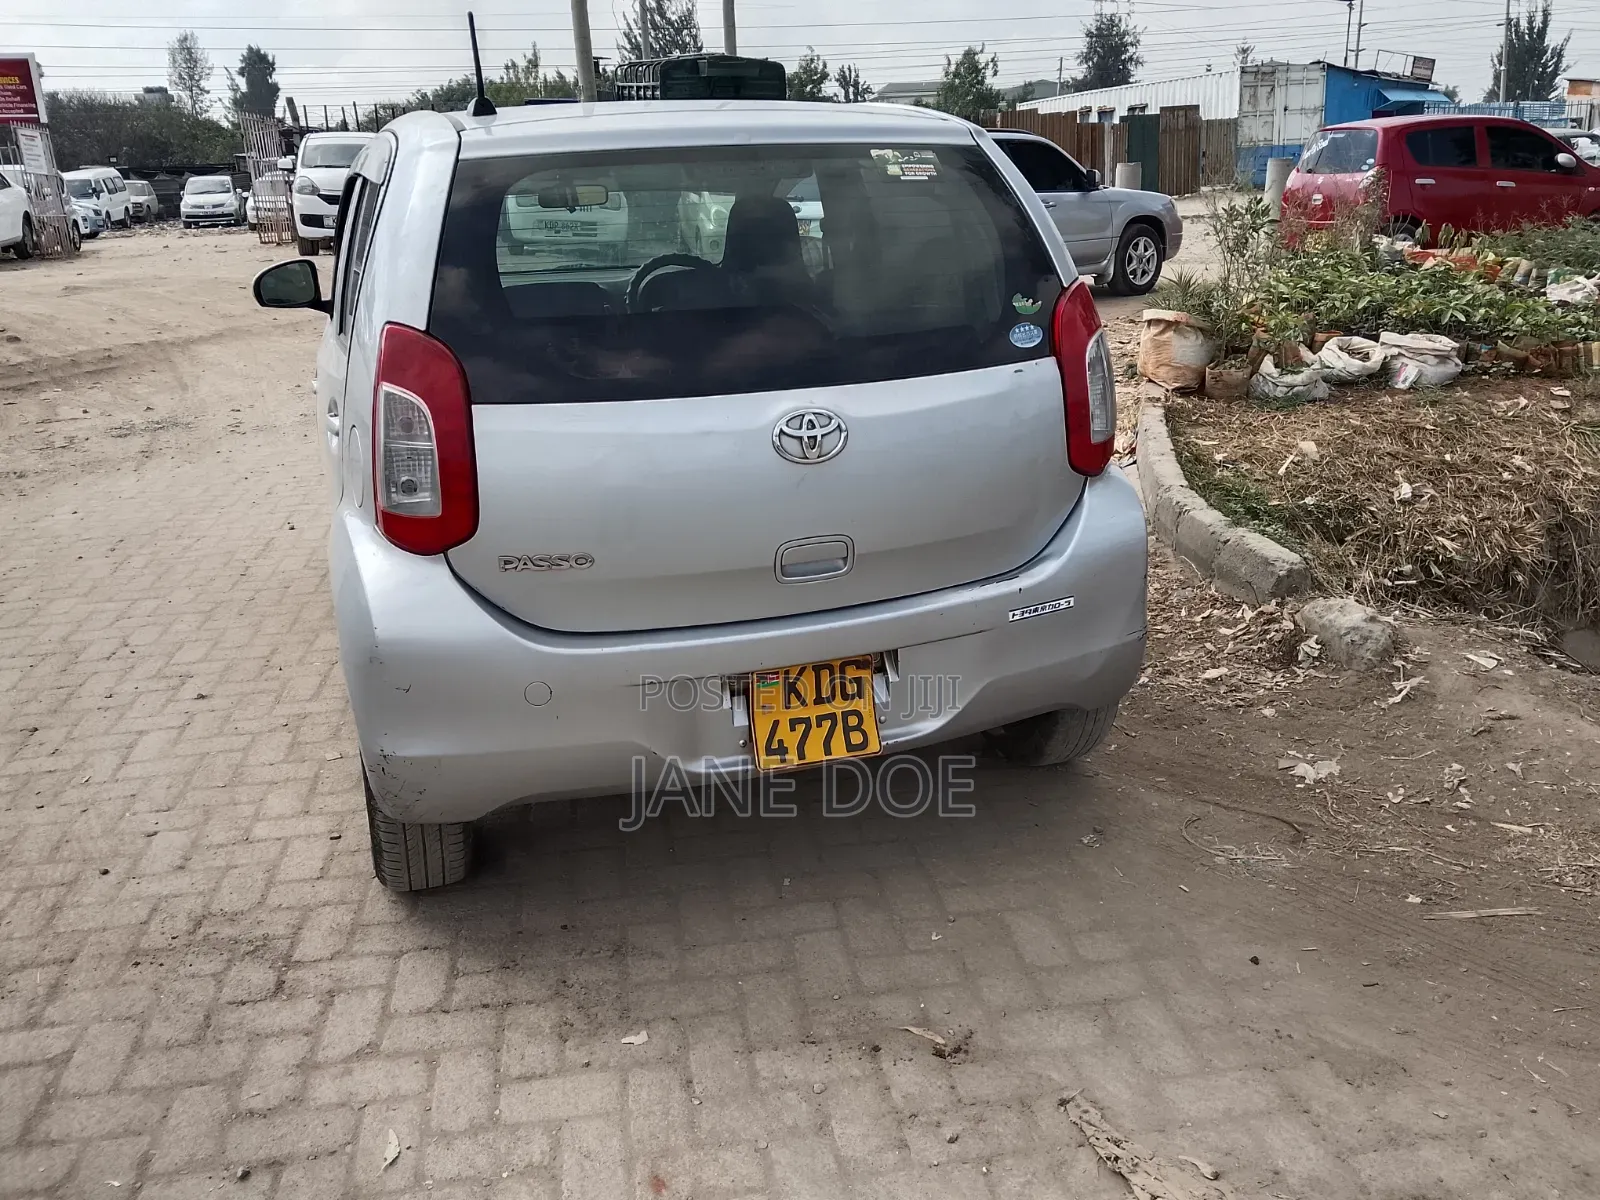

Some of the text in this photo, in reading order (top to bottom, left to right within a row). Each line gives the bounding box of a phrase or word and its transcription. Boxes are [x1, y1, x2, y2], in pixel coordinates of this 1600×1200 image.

[498, 552, 595, 572] PASSO
[783, 659, 867, 710] KDG
[764, 708, 869, 763] 477B
